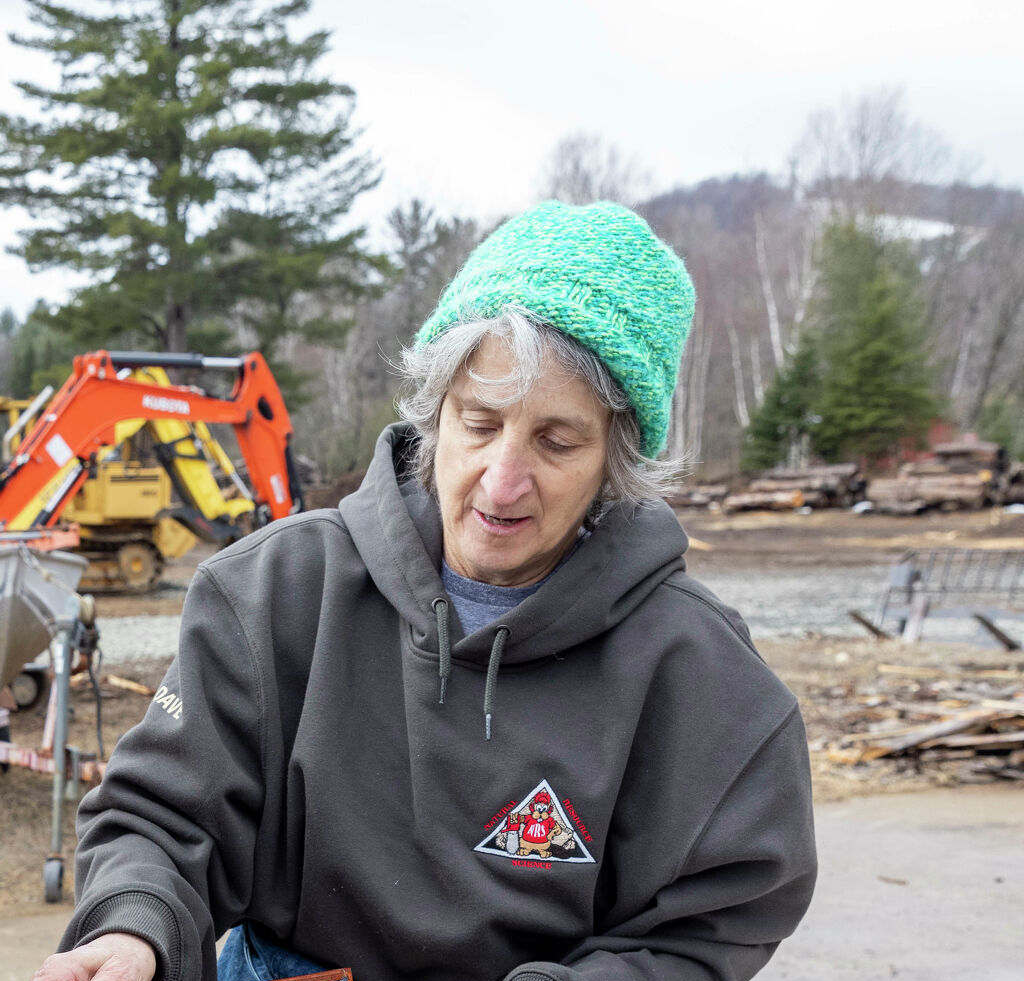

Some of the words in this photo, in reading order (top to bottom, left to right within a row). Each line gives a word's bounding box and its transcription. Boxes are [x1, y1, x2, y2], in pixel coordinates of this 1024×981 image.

[142, 394, 190, 415] KUBOTA
[483, 799, 518, 831] NATURAL
[562, 798, 593, 843] RESOURCE
[527, 823, 547, 838] NRS
[511, 859, 553, 870] SCIENCE
